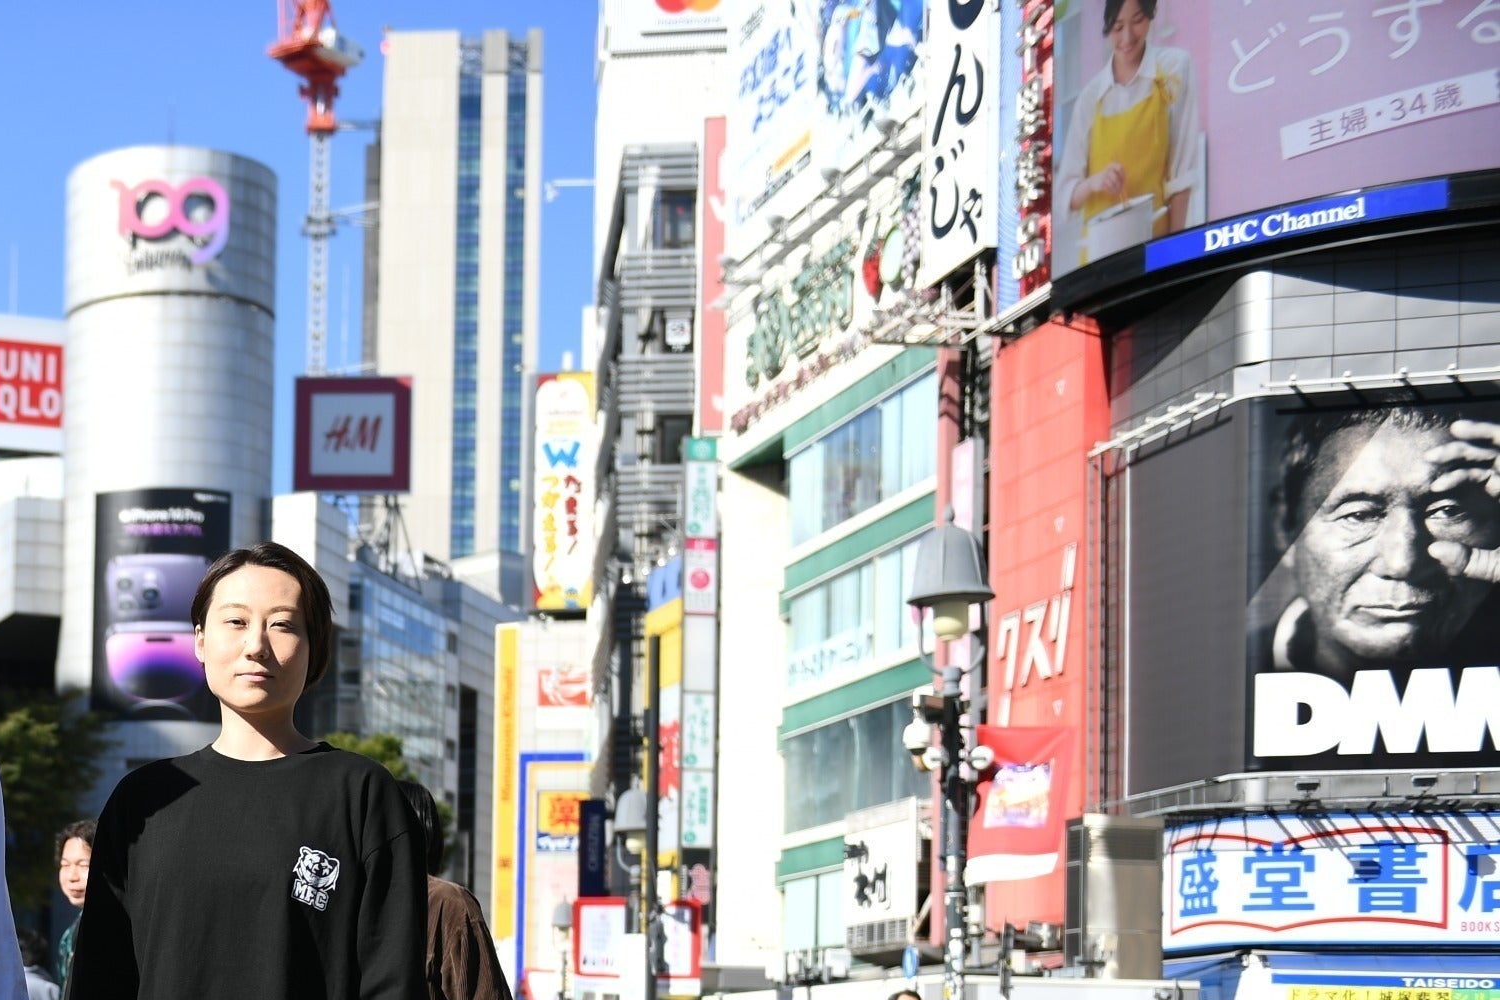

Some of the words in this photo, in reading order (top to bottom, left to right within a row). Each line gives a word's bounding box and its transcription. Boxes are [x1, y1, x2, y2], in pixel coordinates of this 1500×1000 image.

[1308, 82, 1463, 146] 主婦・34歳
[109, 178, 230, 265] 109
[1204, 217, 1259, 251] DHC
[1260, 196, 1366, 238] Channel
[291, 879, 329, 911] MFC
[1402, 977, 1495, 989] TAISEIDO
